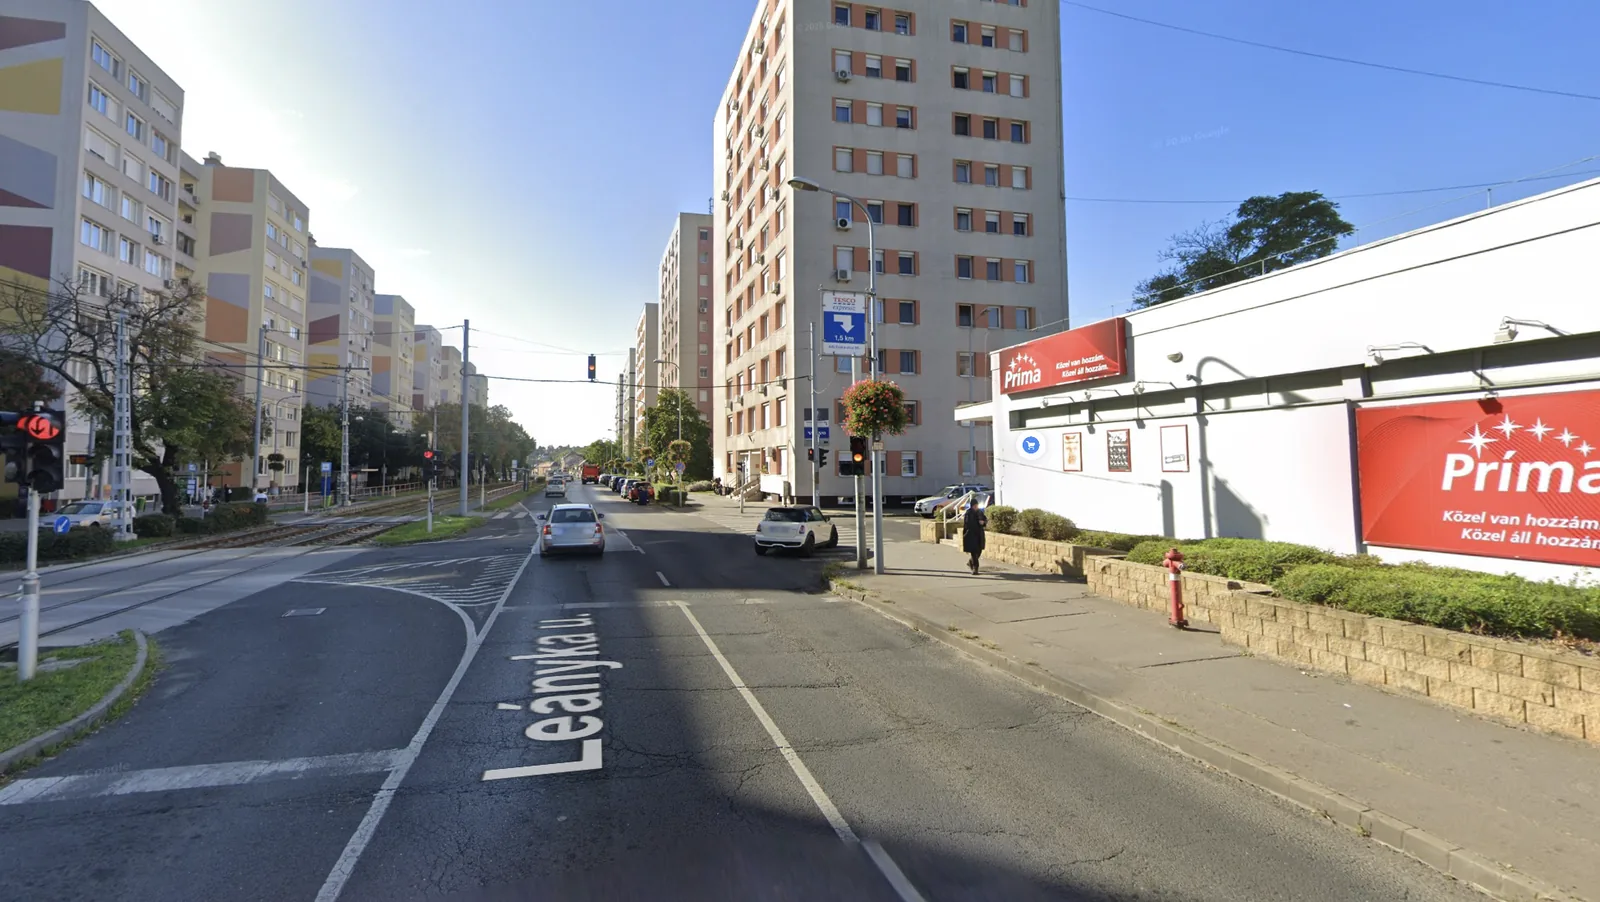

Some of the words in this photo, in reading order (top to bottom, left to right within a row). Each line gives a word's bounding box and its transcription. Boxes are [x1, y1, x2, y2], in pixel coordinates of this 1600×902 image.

[1004, 367, 1041, 388] Príma
[1441, 450, 1600, 494] Príma
[1443, 510, 1486, 524] Közel
[1490, 514, 1521, 526] van
[1461, 528, 1506, 542] Közel
[1510, 531, 1531, 544] áll
[539, 613, 594, 629] u.
[481, 633, 623, 781] Leányka
